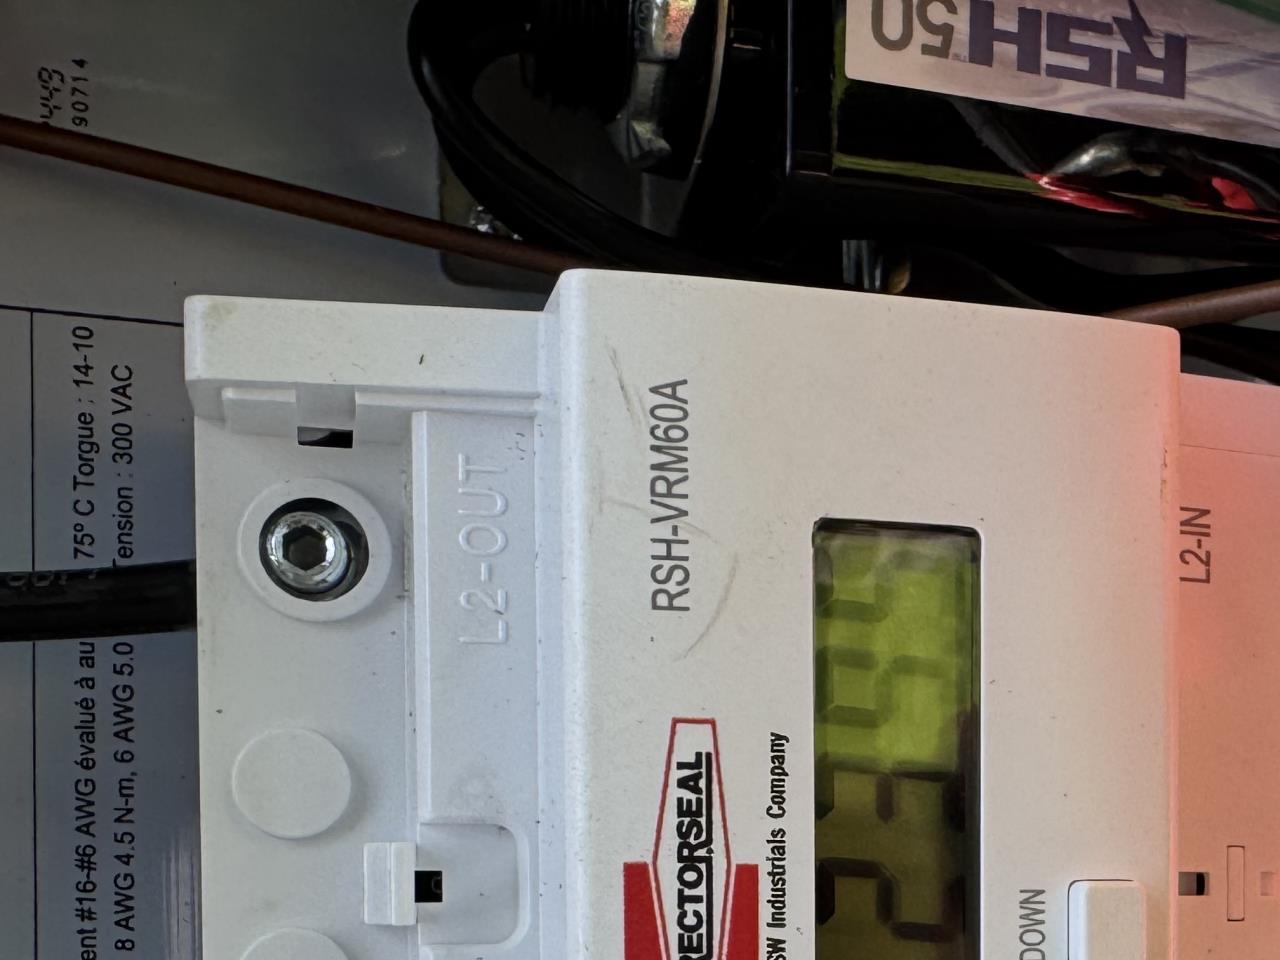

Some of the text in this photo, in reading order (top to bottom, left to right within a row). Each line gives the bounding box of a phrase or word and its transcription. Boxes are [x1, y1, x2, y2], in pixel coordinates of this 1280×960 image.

[71, 326, 95, 387] 14-10
[110, 364, 133, 416] VAC
[111, 422, 133, 465] 300
[72, 499, 95, 516] C
[648, 379, 690, 612] RSH-VRM60A
[458, 452, 508, 644] L2-OUT
[1178, 506, 1211, 585] L2-IN
[74, 677, 96, 690] à
[79, 642, 96, 668] au
[112, 642, 134, 676] 5.0
[74, 697, 96, 771] évalué
[112, 684, 134, 743] AWG
[113, 750, 135, 763] 6
[765, 731, 789, 819] Company
[74, 778, 96, 838] AWG
[113, 771, 137, 823] N-m,
[113, 832, 135, 866] 4.5
[765, 828, 787, 928] Industrials
[75, 844, 97, 922] #16-#6
[113, 873, 135, 932] AWG
[114, 939, 136, 951] 8
